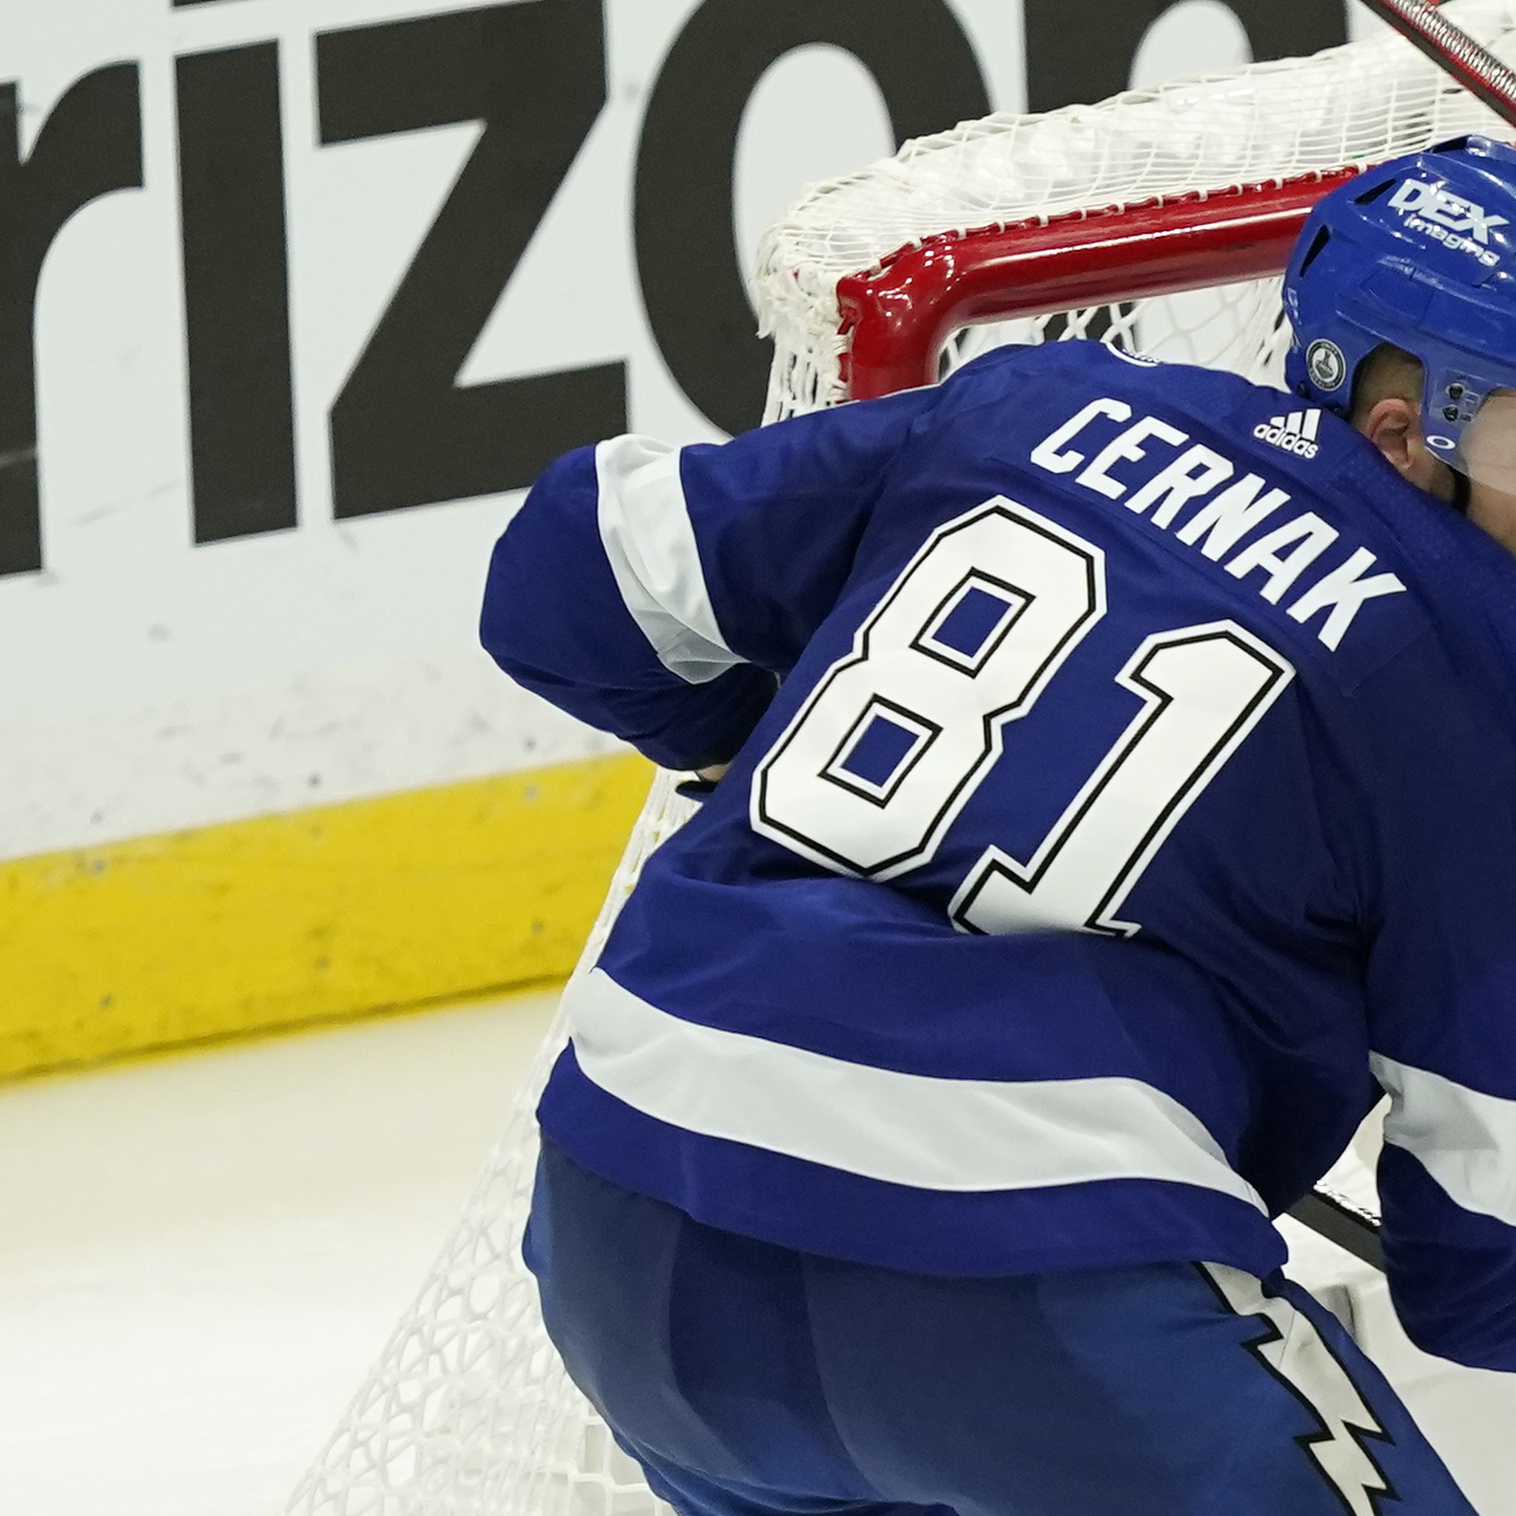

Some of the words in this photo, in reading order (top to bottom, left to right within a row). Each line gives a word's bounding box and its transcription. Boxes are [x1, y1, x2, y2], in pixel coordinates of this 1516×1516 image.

[1388, 178, 1510, 245] DEX
[1403, 213, 1502, 267] imaging
[1253, 422, 1319, 460] adidas
[1030, 397, 1407, 652] CERNAK
[749, 494, 1296, 938] 81
